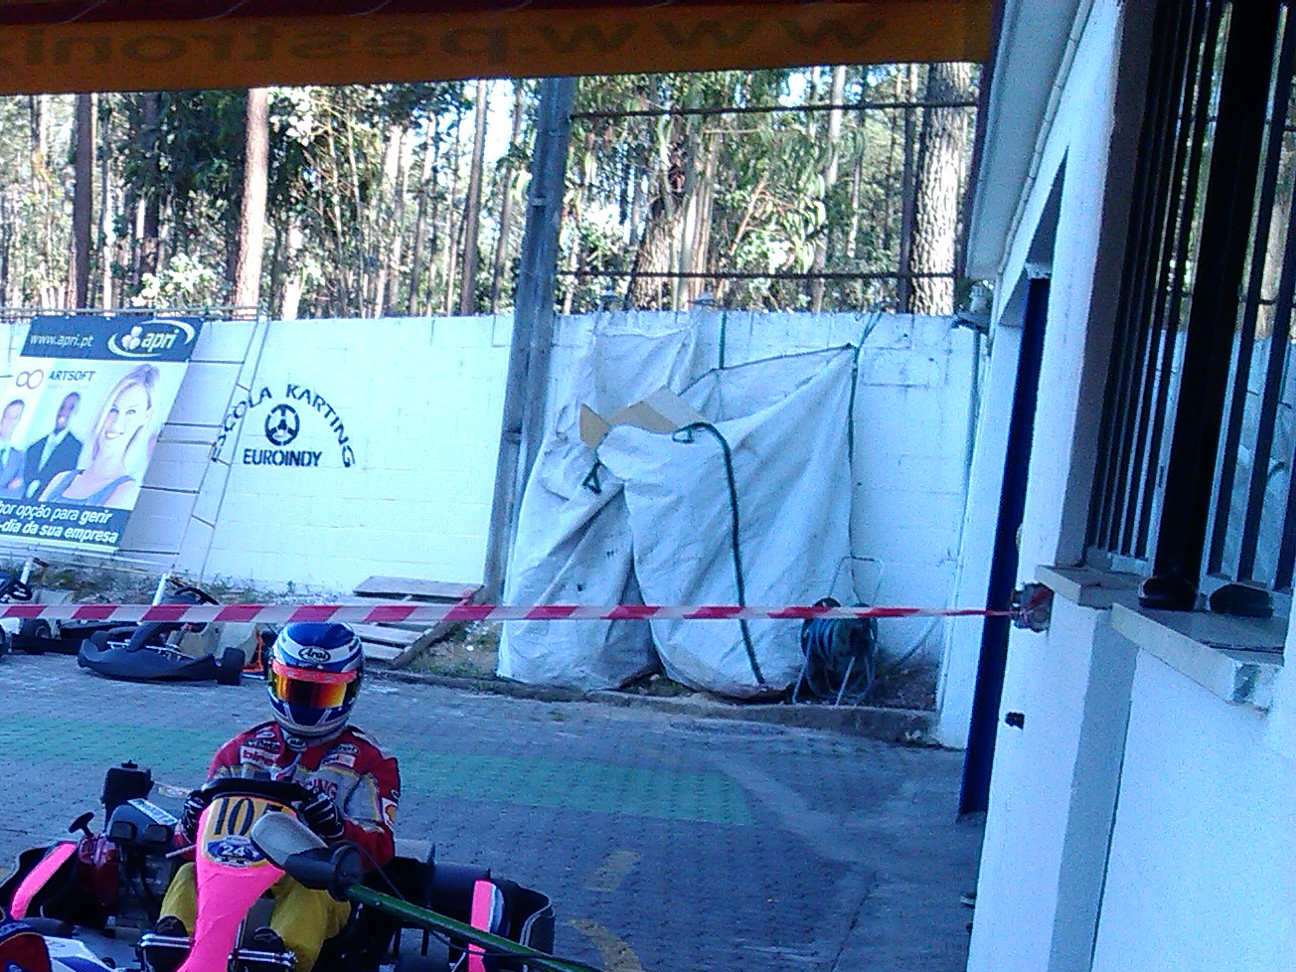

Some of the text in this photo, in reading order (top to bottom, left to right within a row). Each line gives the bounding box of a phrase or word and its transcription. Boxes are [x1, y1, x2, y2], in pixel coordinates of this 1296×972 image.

[30, 334, 94, 349] www.apri.pt
[141, 328, 180, 353] apri
[48, 370, 96, 382] ARTSOFT
[285, 383, 355, 468] KARTING
[243, 448, 322, 467] EUROINDY
[15, 504, 52, 520] opção
[49, 508, 79, 521] para
[78, 509, 113, 525] gerir
[21, 521, 39, 535] da
[38, 525, 63, 537] sua
[64, 526, 119, 543] empresa
[220, 844, 246, 857] 24
